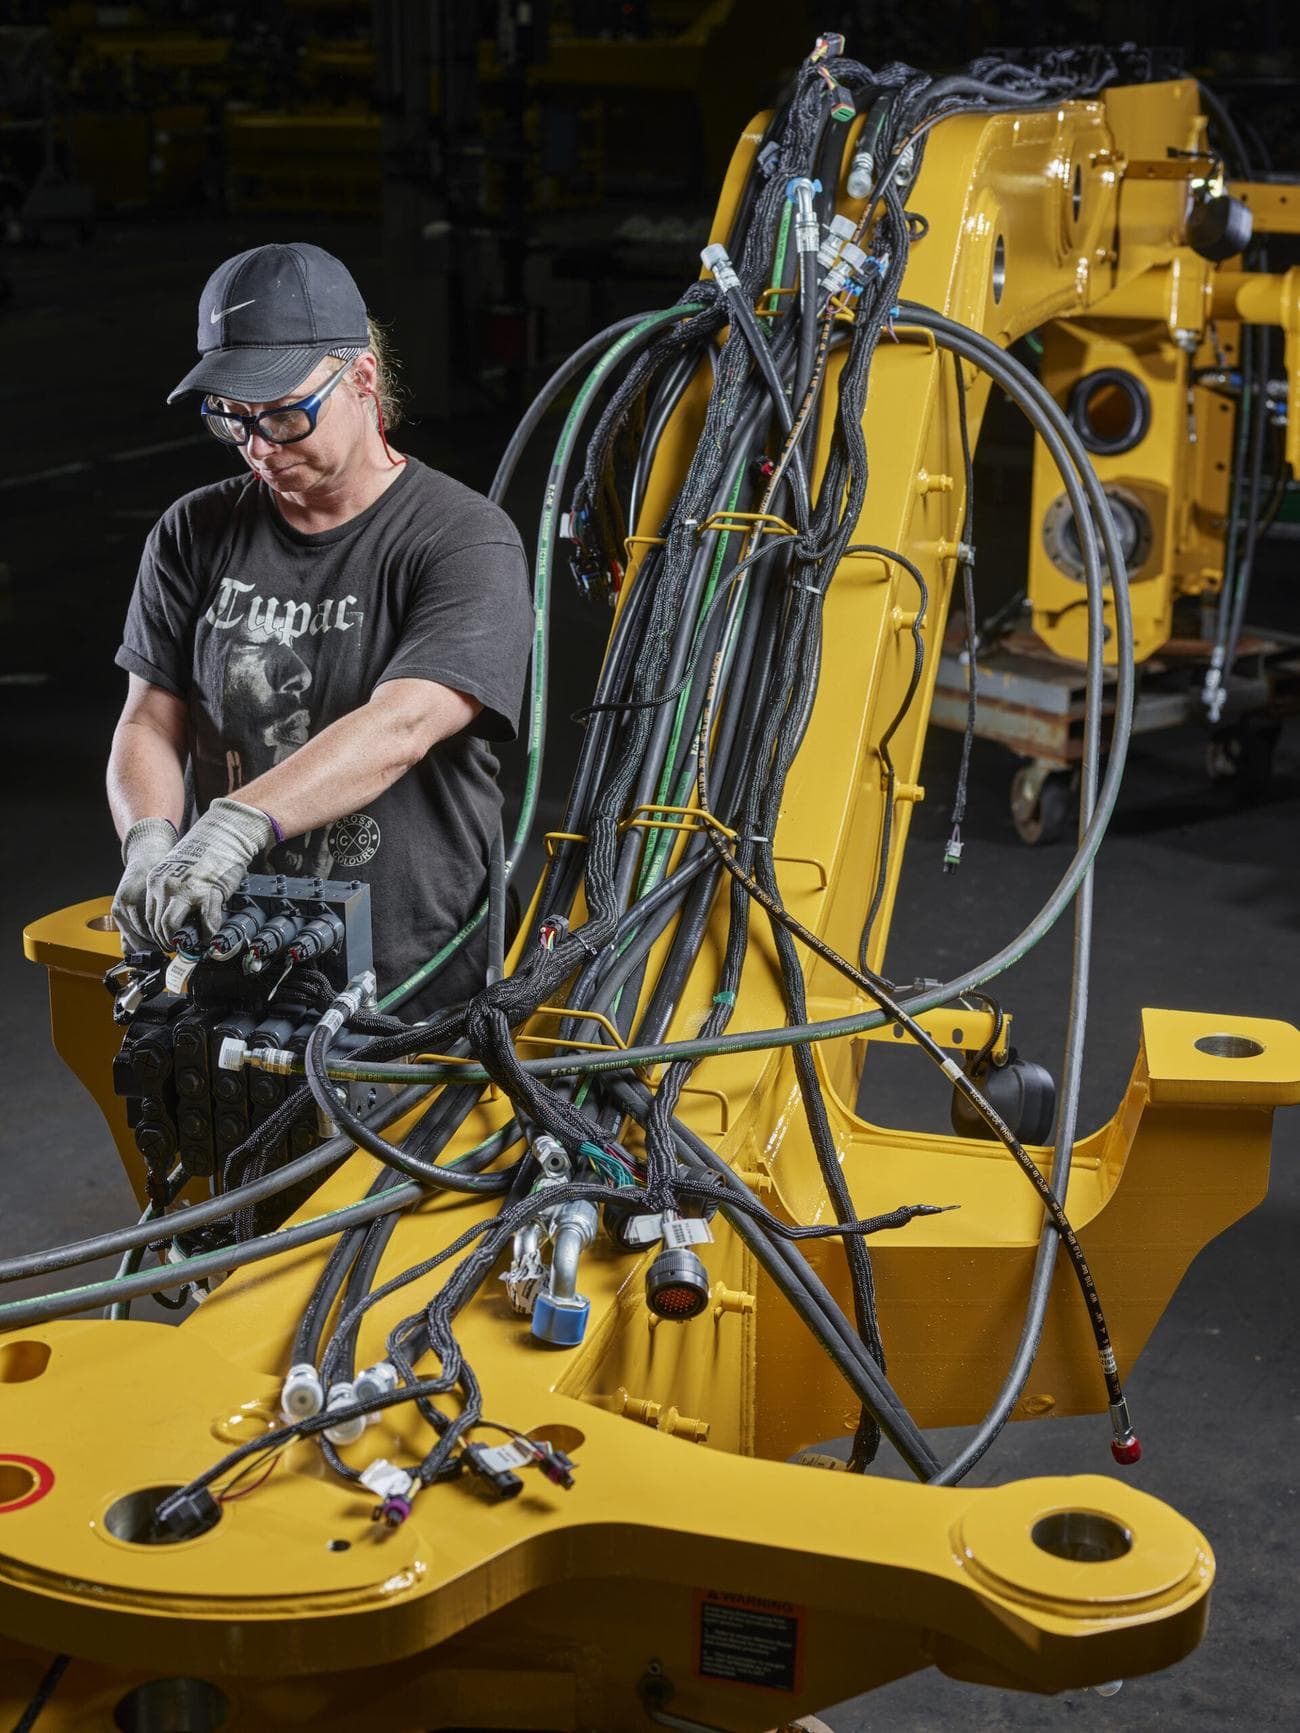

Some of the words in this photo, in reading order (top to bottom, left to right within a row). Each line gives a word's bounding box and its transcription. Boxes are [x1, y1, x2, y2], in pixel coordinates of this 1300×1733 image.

[205, 577, 357, 647] Tupac
[335, 815, 372, 828] CROSS
[332, 846, 374, 865] COLOURS
